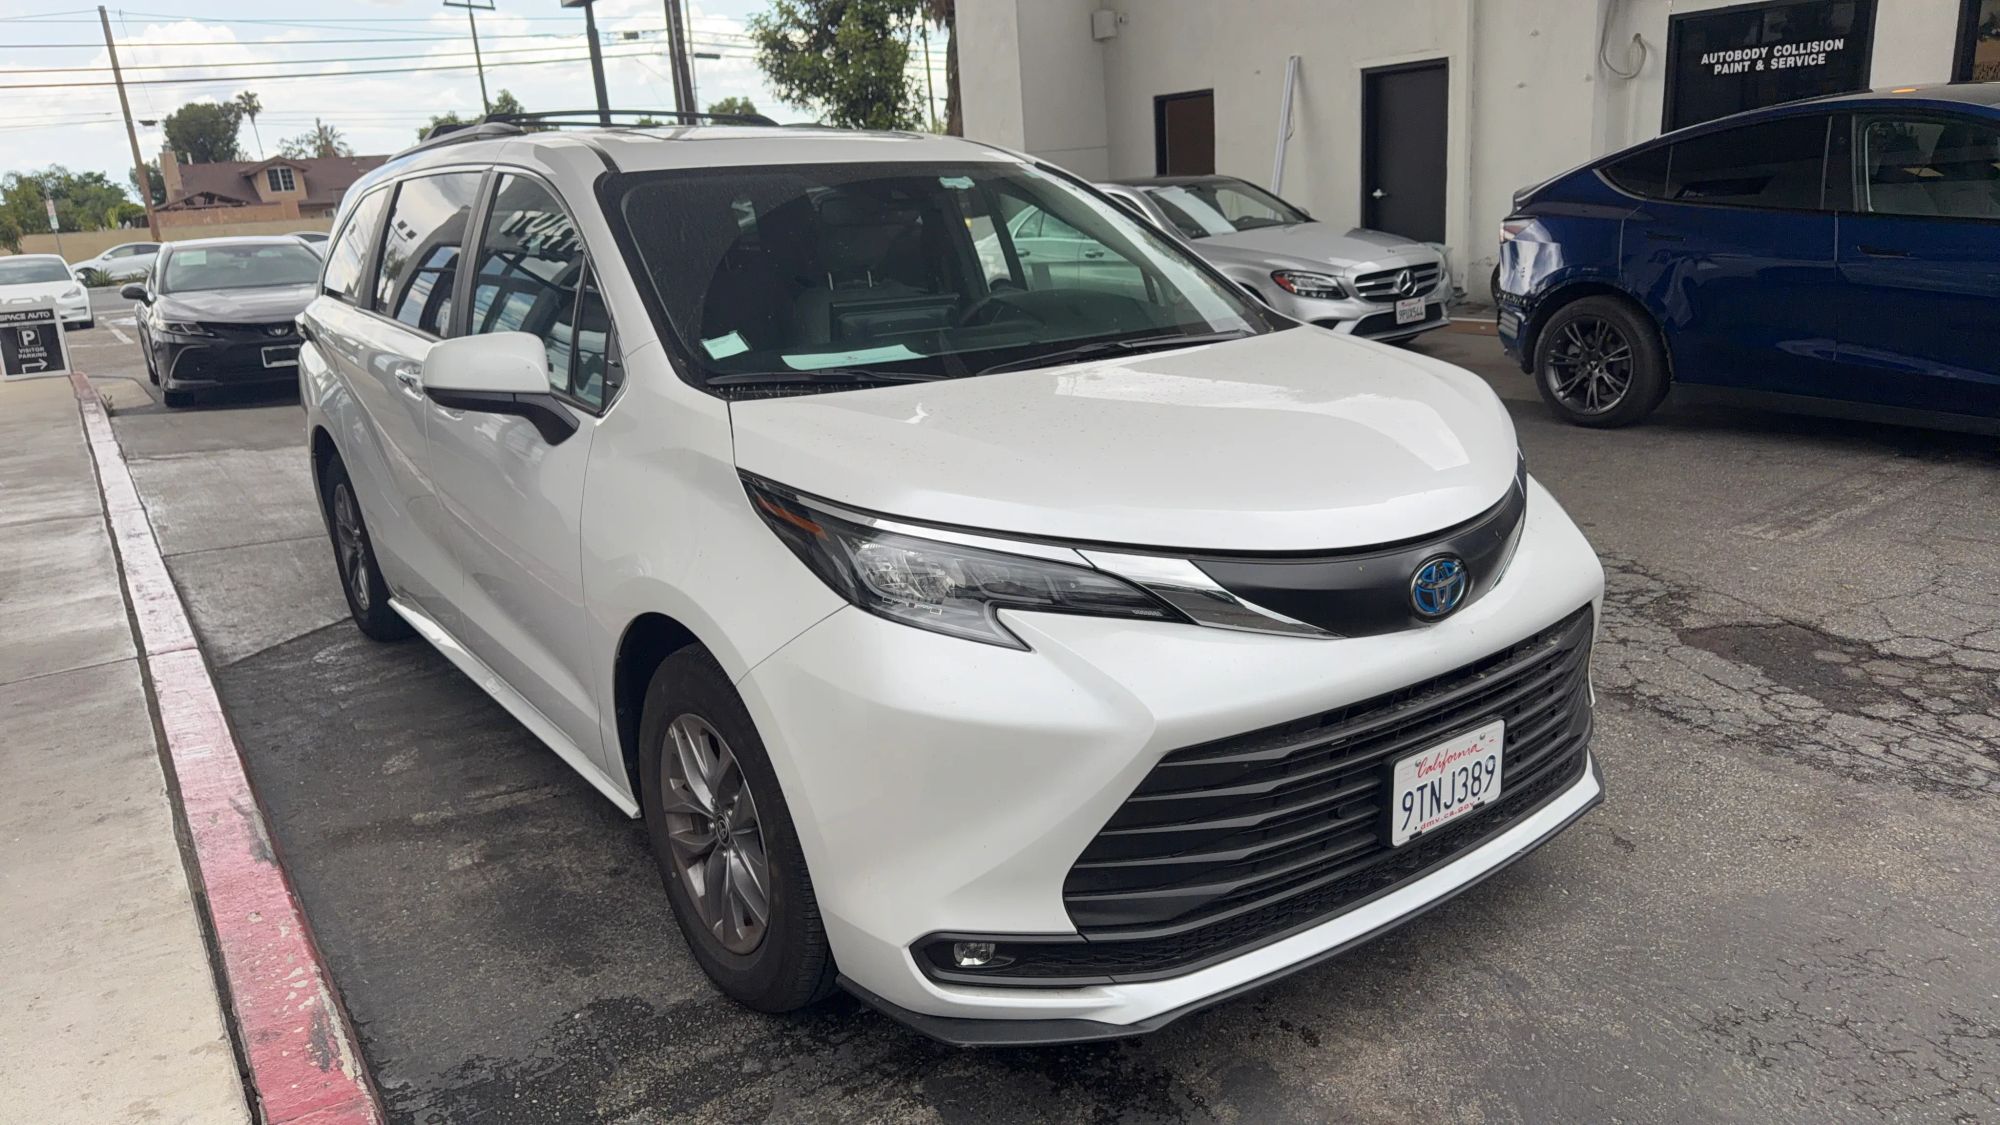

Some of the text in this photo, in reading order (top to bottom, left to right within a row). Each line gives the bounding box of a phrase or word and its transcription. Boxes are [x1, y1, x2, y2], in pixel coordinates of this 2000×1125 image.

[1701, 38, 1844, 65] AUTOBODY COLLISION
[1714, 53, 1826, 75] PAINT & SERVICE
[27, 311, 50, 320] AUTO
[21, 330, 35, 346] P
[19, 346, 45, 354] VISITOR
[1417, 743, 1484, 778] California
[1402, 755, 1496, 831] 9TNJ389
